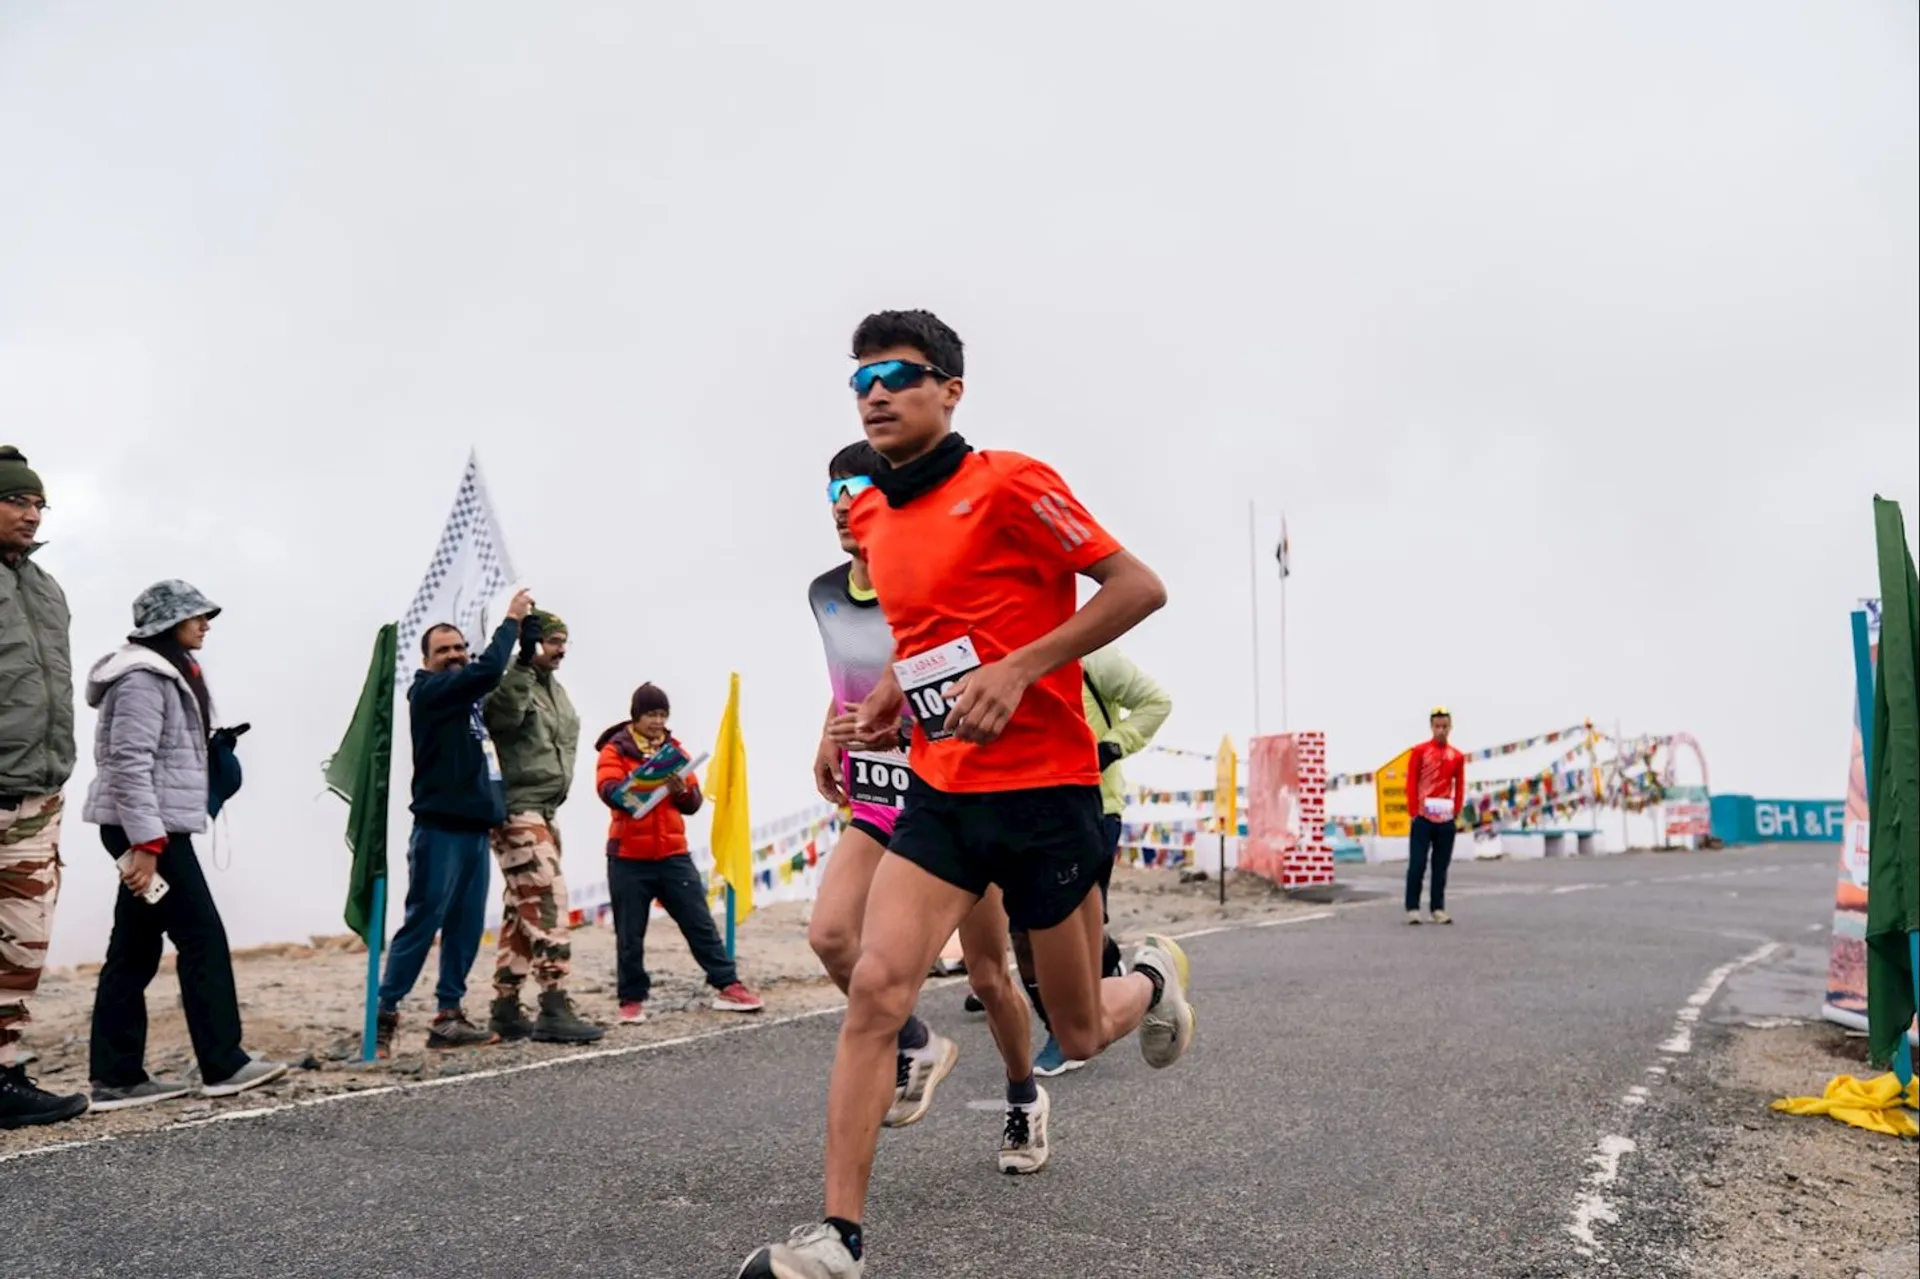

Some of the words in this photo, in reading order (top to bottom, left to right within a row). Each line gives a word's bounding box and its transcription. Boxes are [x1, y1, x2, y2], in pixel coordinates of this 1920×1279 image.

[855, 761, 910, 791] 100
[1755, 803, 1799, 837] GH
[1804, 810, 1823, 836] &
